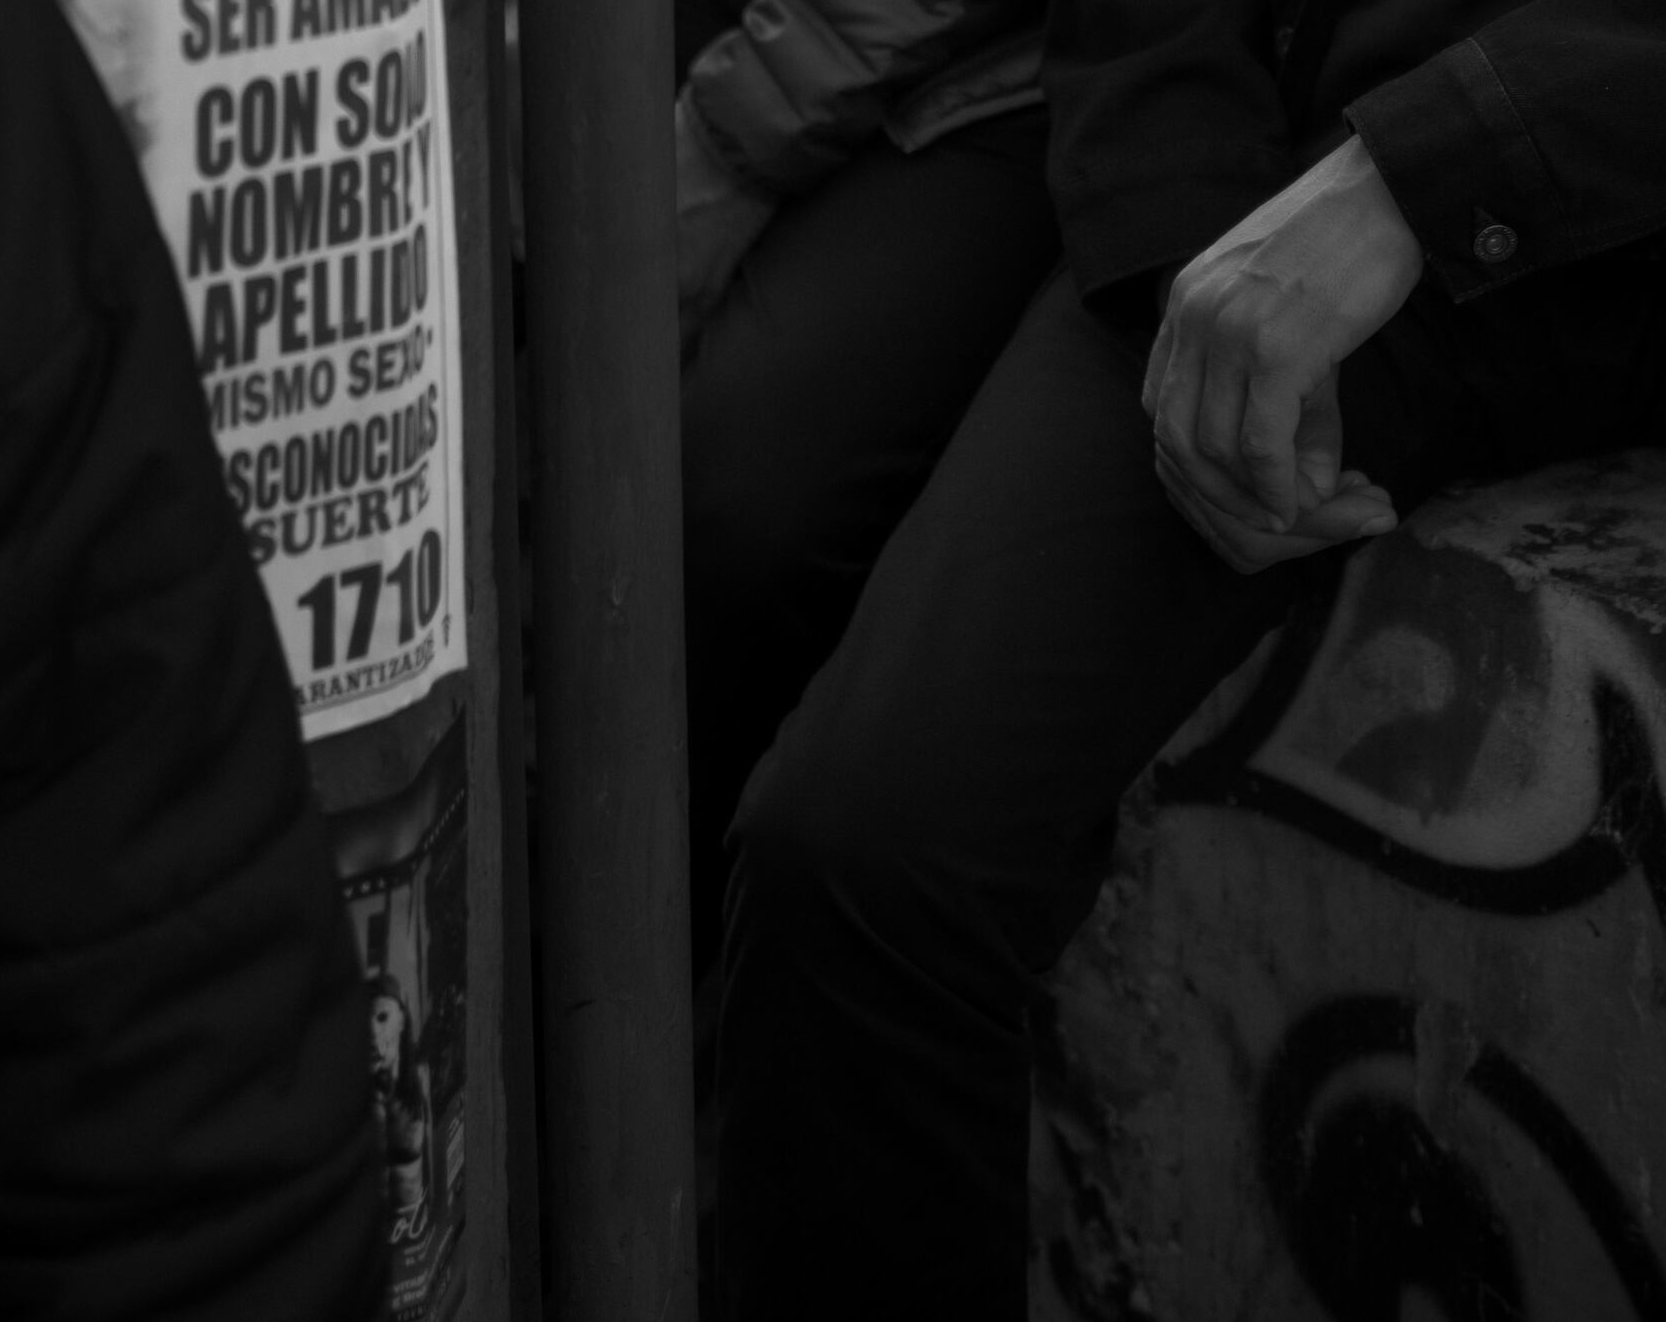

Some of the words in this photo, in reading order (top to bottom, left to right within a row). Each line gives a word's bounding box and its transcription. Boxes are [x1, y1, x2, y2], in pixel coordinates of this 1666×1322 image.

[197, 69, 319, 178] CON
[188, 139, 414, 279] NOMBRE
[201, 223, 428, 379] APELLIDO
[247, 461, 431, 567] SUERTE
[298, 528, 442, 672] 1710
